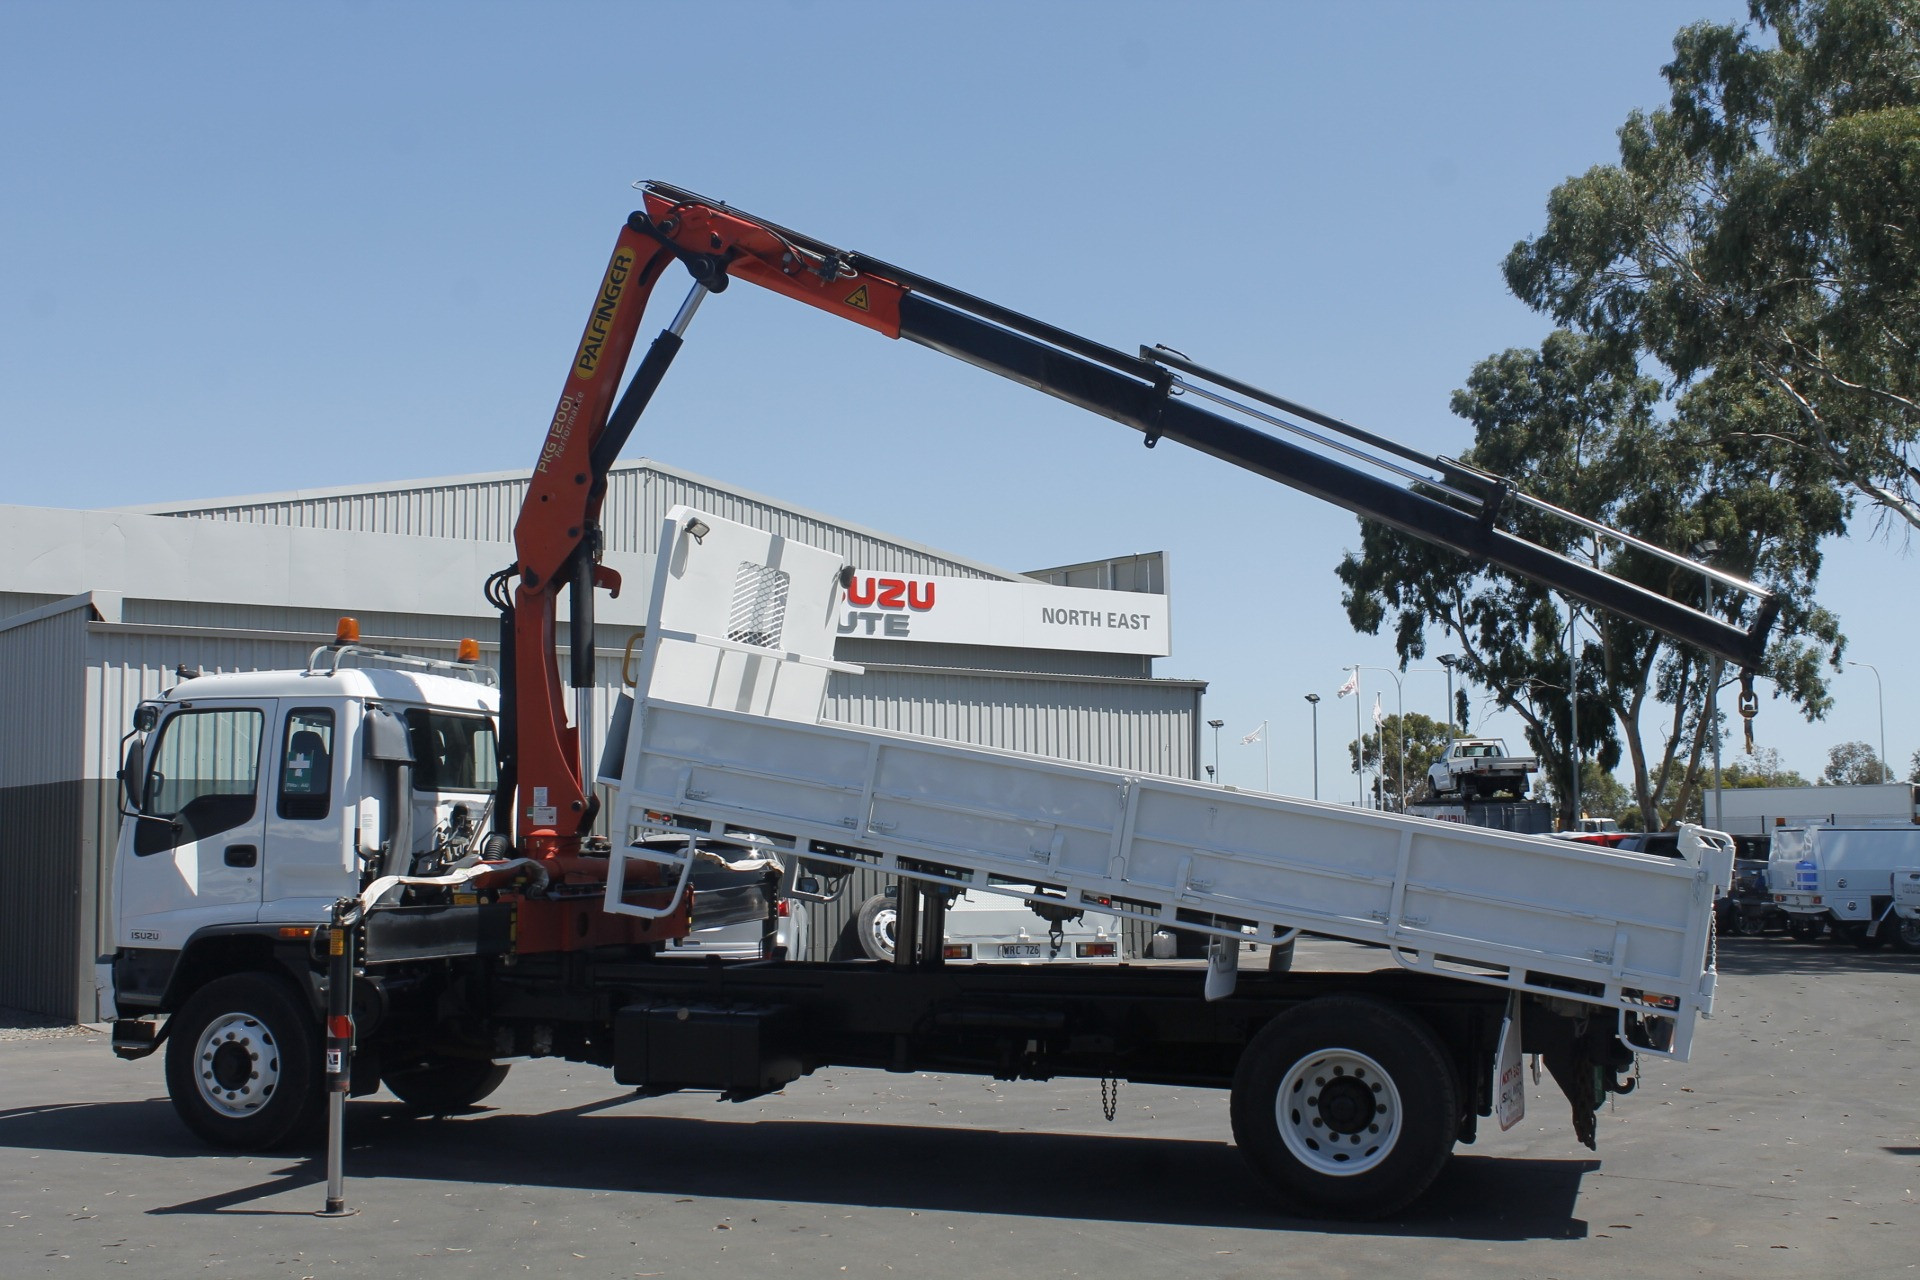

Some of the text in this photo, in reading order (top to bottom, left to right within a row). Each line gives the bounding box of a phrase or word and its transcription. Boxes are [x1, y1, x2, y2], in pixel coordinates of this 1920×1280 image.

[578, 254, 632, 371] PALFINGER
[537, 441, 557, 473] PKG
[842, 576, 935, 611] UZU
[1042, 607, 1151, 630] NORTH EAST
[131, 931, 159, 940] ISUZU
[1003, 945, 1040, 955] WRC 726
